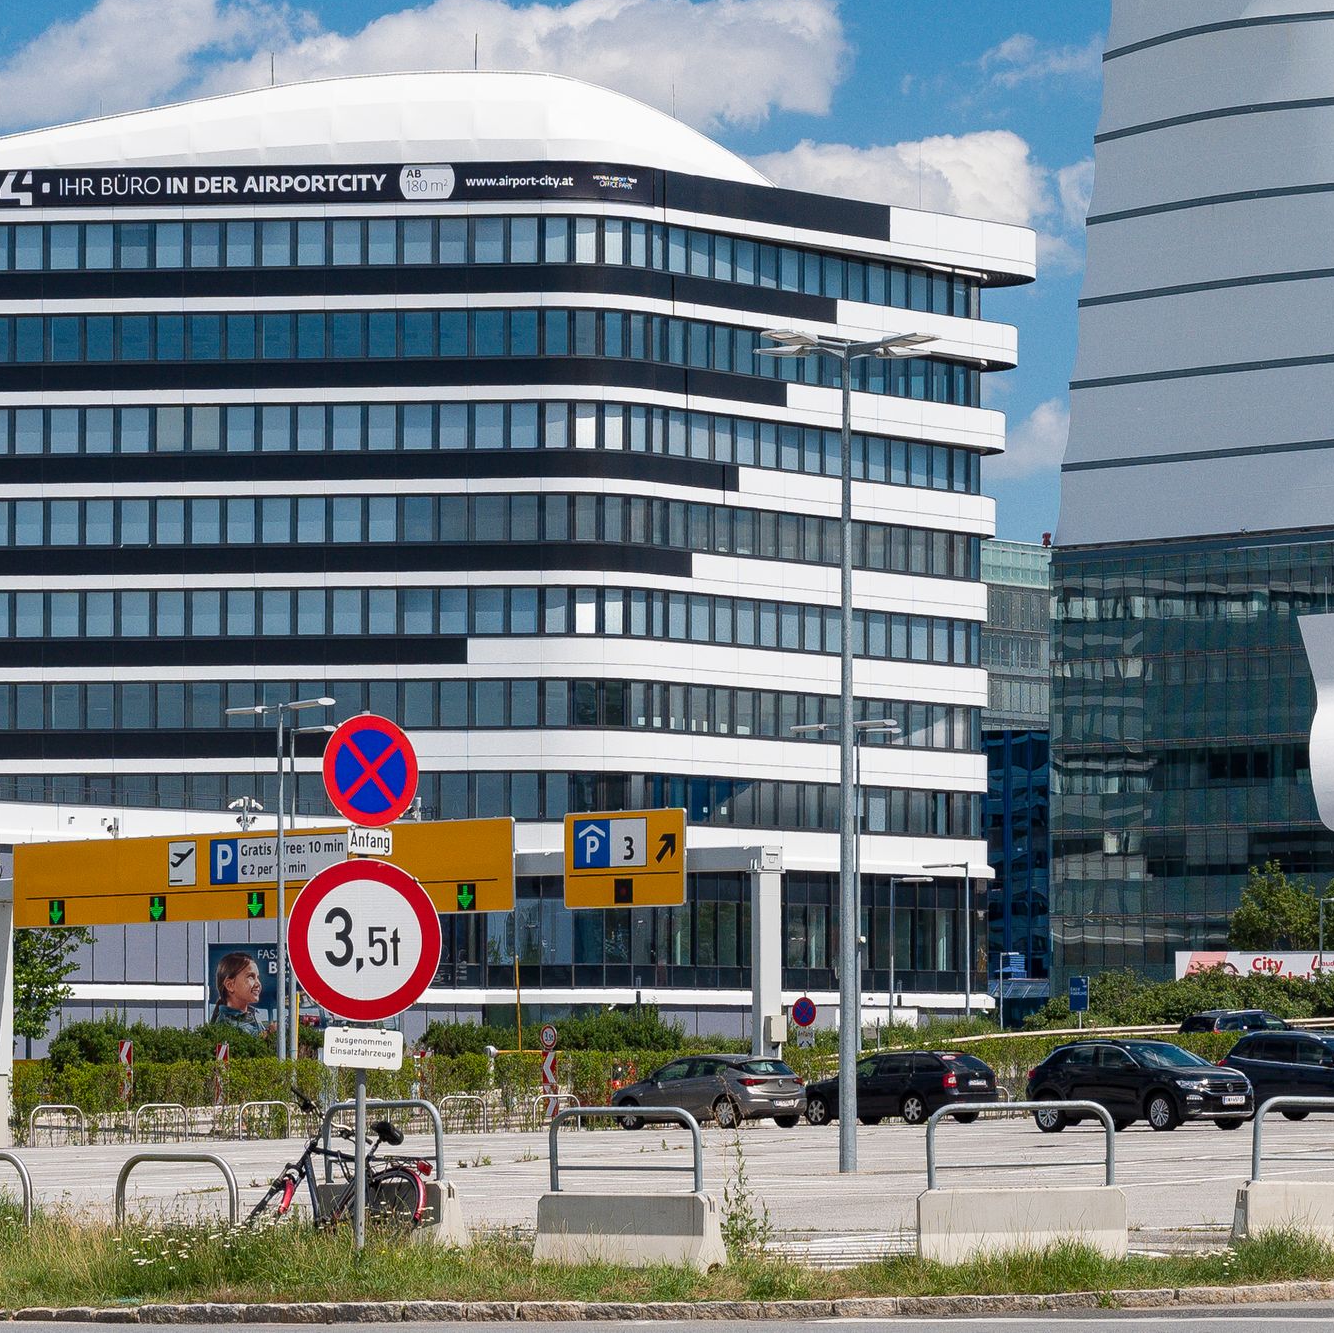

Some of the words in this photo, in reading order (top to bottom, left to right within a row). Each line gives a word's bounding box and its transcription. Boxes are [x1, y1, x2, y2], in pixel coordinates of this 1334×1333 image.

[406, 169, 422, 178] AB
[465, 174, 574, 189] www.airport-city.at
[59, 177, 95, 196] IHR
[101, 173, 161, 195] BÜRO
[166, 177, 188, 194] IN
[194, 176, 239, 193] DER
[243, 173, 387, 193] AIRPORTCITY
[406, 179, 428, 192] 180
[240, 844, 272, 856] Gratis
[308, 841, 321, 854] 10
[324, 838, 344, 853] min
[350, 831, 390, 854] Anfang
[586, 835, 600, 863] P
[623, 836, 635, 860] 3
[216, 843, 233, 879] P
[241, 865, 247, 875] €
[249, 865, 255, 875] 2
[257, 866, 273, 877] per
[288, 860, 307, 873] min
[1252, 956, 1283, 974] City
[334, 1036, 393, 1048] ausgenommen
[330, 1046, 396, 1059] Einsatzfahrzeuge
